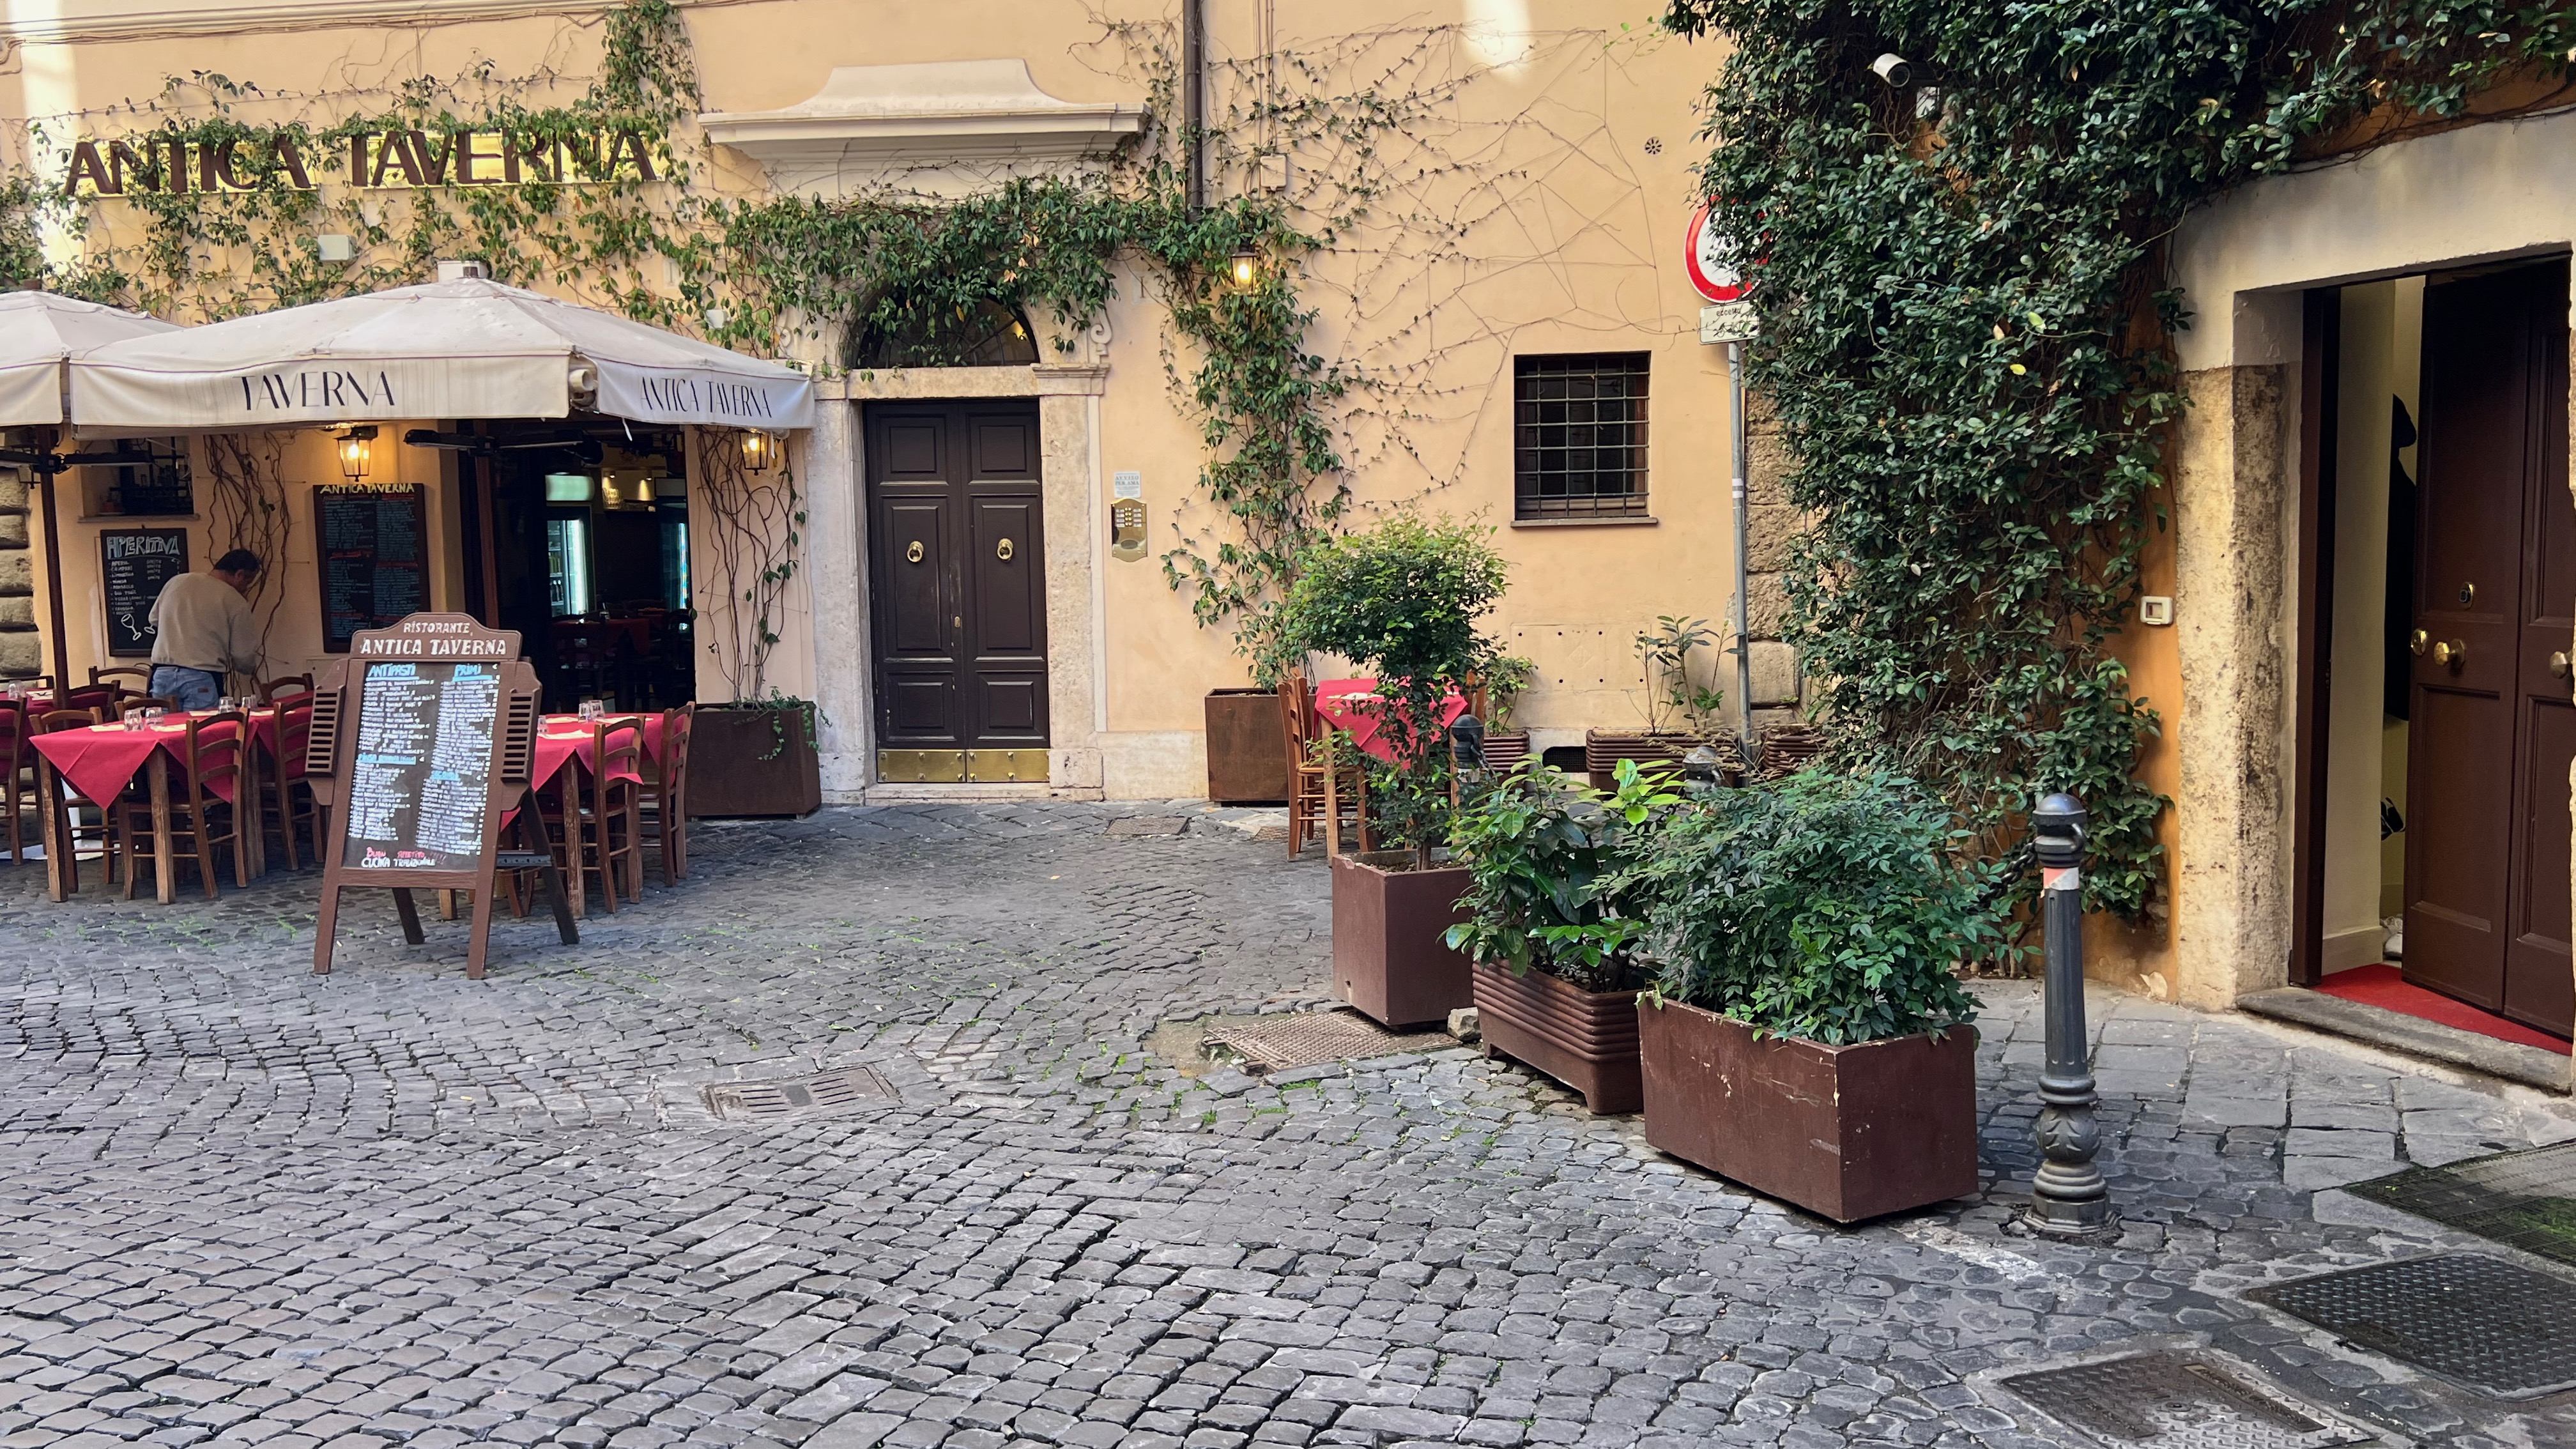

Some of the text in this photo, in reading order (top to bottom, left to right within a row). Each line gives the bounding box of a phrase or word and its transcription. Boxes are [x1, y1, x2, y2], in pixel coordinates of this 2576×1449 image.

[65, 128, 657, 194] ANTICA TAVERNA
[233, 371, 394, 410] TAVERNA
[640, 377, 772, 418] ANTICA TAVERNA
[319, 483, 415, 494] ANTICA TAVERNA
[403, 621, 470, 633] RISTORANTE
[360, 639, 506, 655] ANTICA TAVERNA
